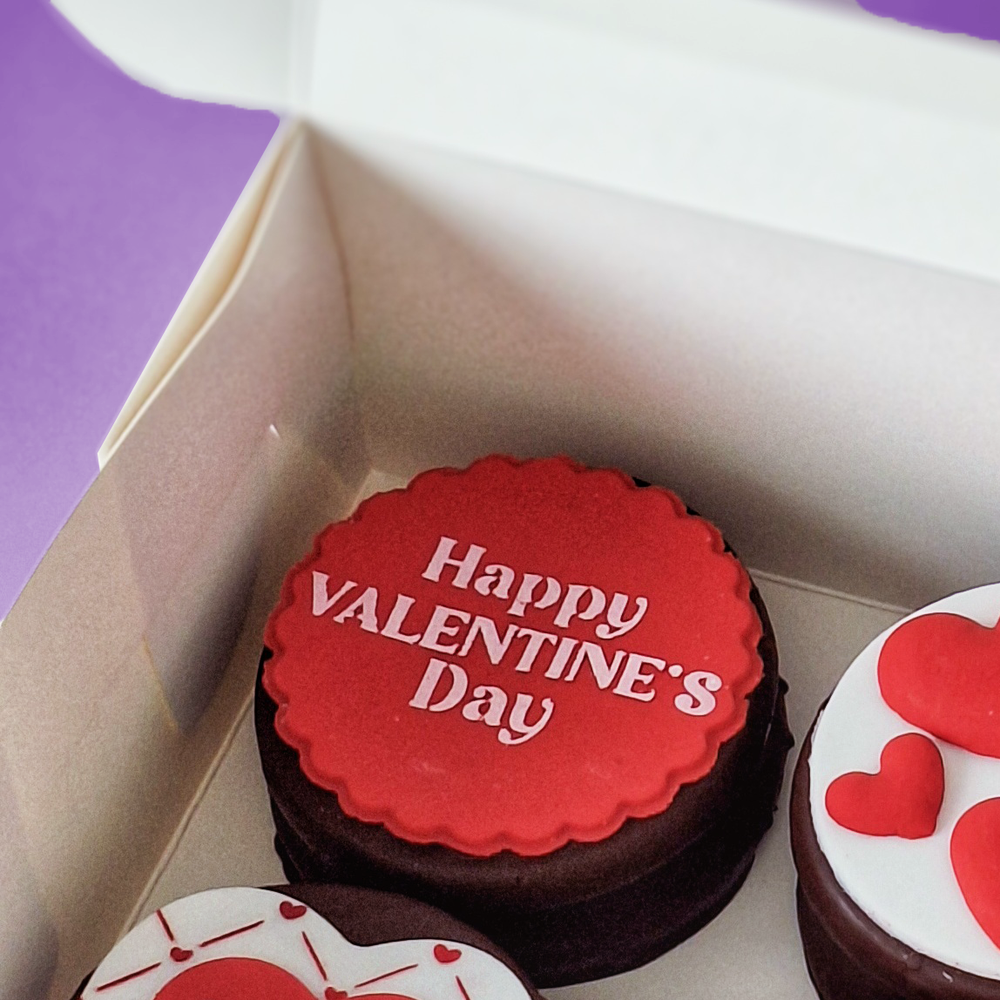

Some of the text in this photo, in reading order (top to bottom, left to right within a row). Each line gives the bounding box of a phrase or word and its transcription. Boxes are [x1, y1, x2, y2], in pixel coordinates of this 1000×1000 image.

[421, 536, 648, 639] Happy
[310, 571, 723, 716] VALENTINE'S
[409, 658, 555, 745] Day
